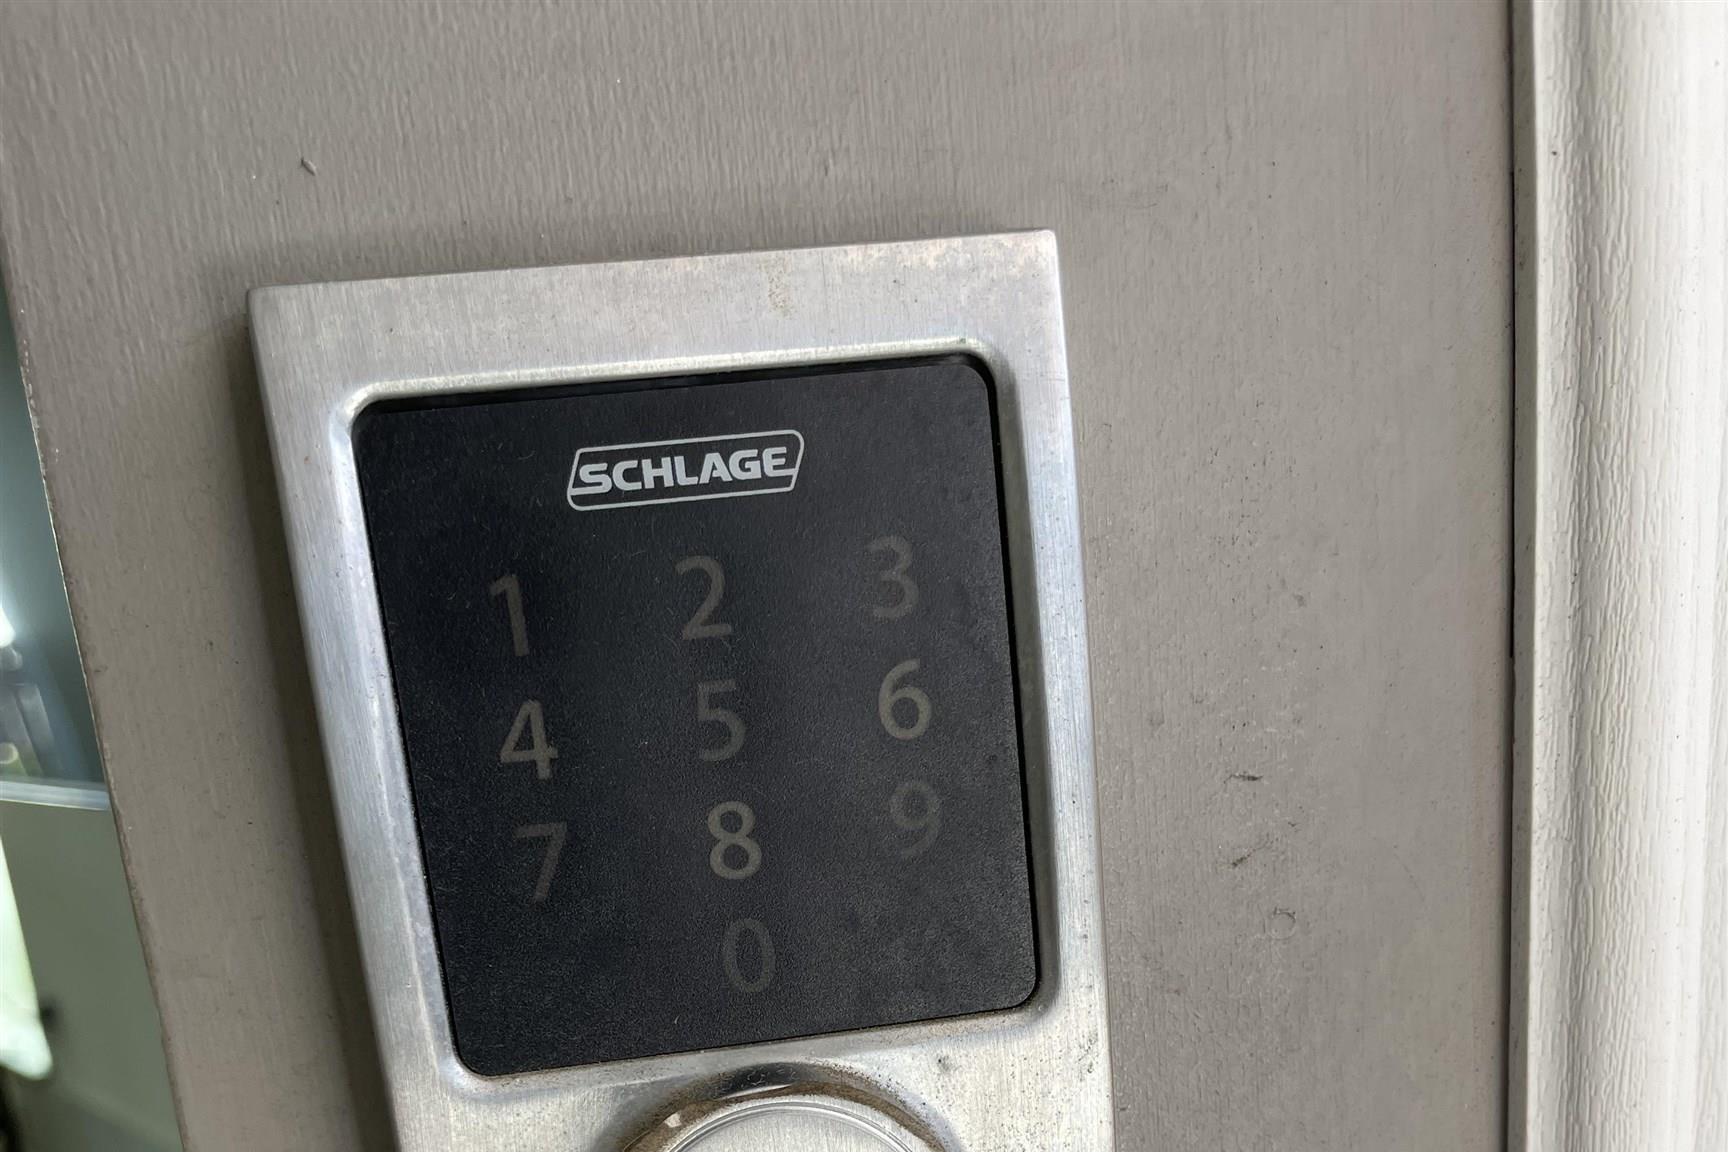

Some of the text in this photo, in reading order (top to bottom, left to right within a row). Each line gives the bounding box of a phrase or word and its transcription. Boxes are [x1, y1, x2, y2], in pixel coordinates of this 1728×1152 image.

[576, 445, 790, 495] SCHLAGE
[489, 535, 920, 658] 1 2 3
[500, 659, 932, 780] 4 5 6
[513, 780, 942, 902] 7 8 9
[721, 917, 776, 993] 0
